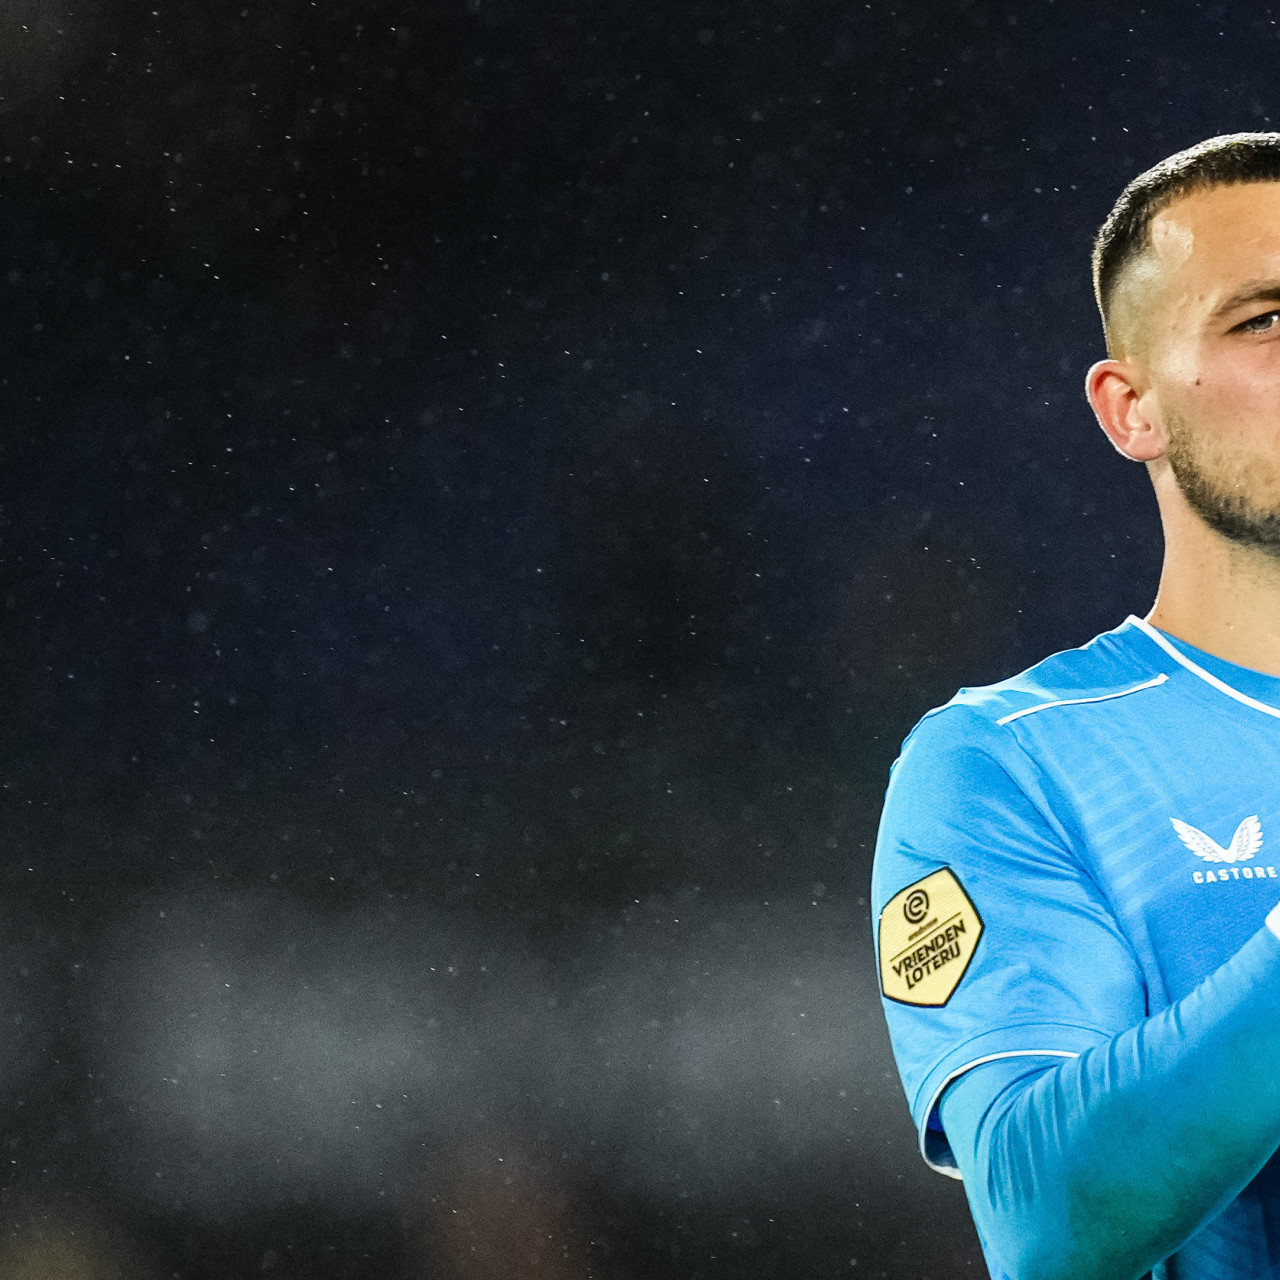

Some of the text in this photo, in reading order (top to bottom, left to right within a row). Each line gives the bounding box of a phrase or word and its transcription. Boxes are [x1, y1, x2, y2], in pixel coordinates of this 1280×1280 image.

[1193, 866, 1278, 884] CASTORE
[892, 918, 966, 977] VRIENDEN
[905, 941, 961, 990] LOTERIJ
